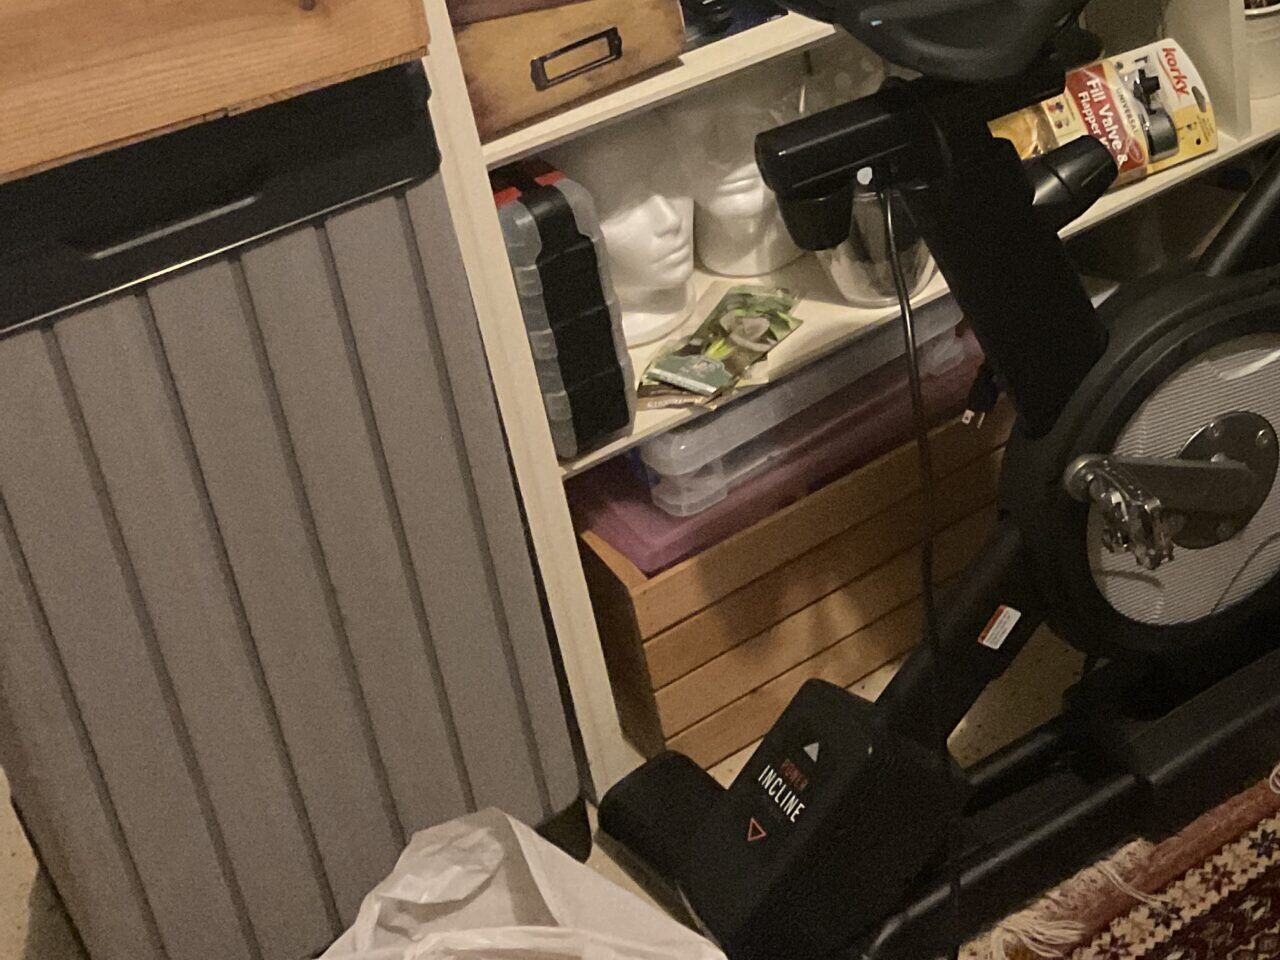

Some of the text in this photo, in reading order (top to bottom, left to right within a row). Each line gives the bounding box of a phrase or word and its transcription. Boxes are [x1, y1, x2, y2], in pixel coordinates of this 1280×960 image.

[1161, 46, 1190, 97] korky
[1077, 90, 1102, 136] Flapper
[1086, 78, 1107, 103] Fill
[1101, 104, 1123, 151] Valve
[757, 764, 807, 824] INCLINE
